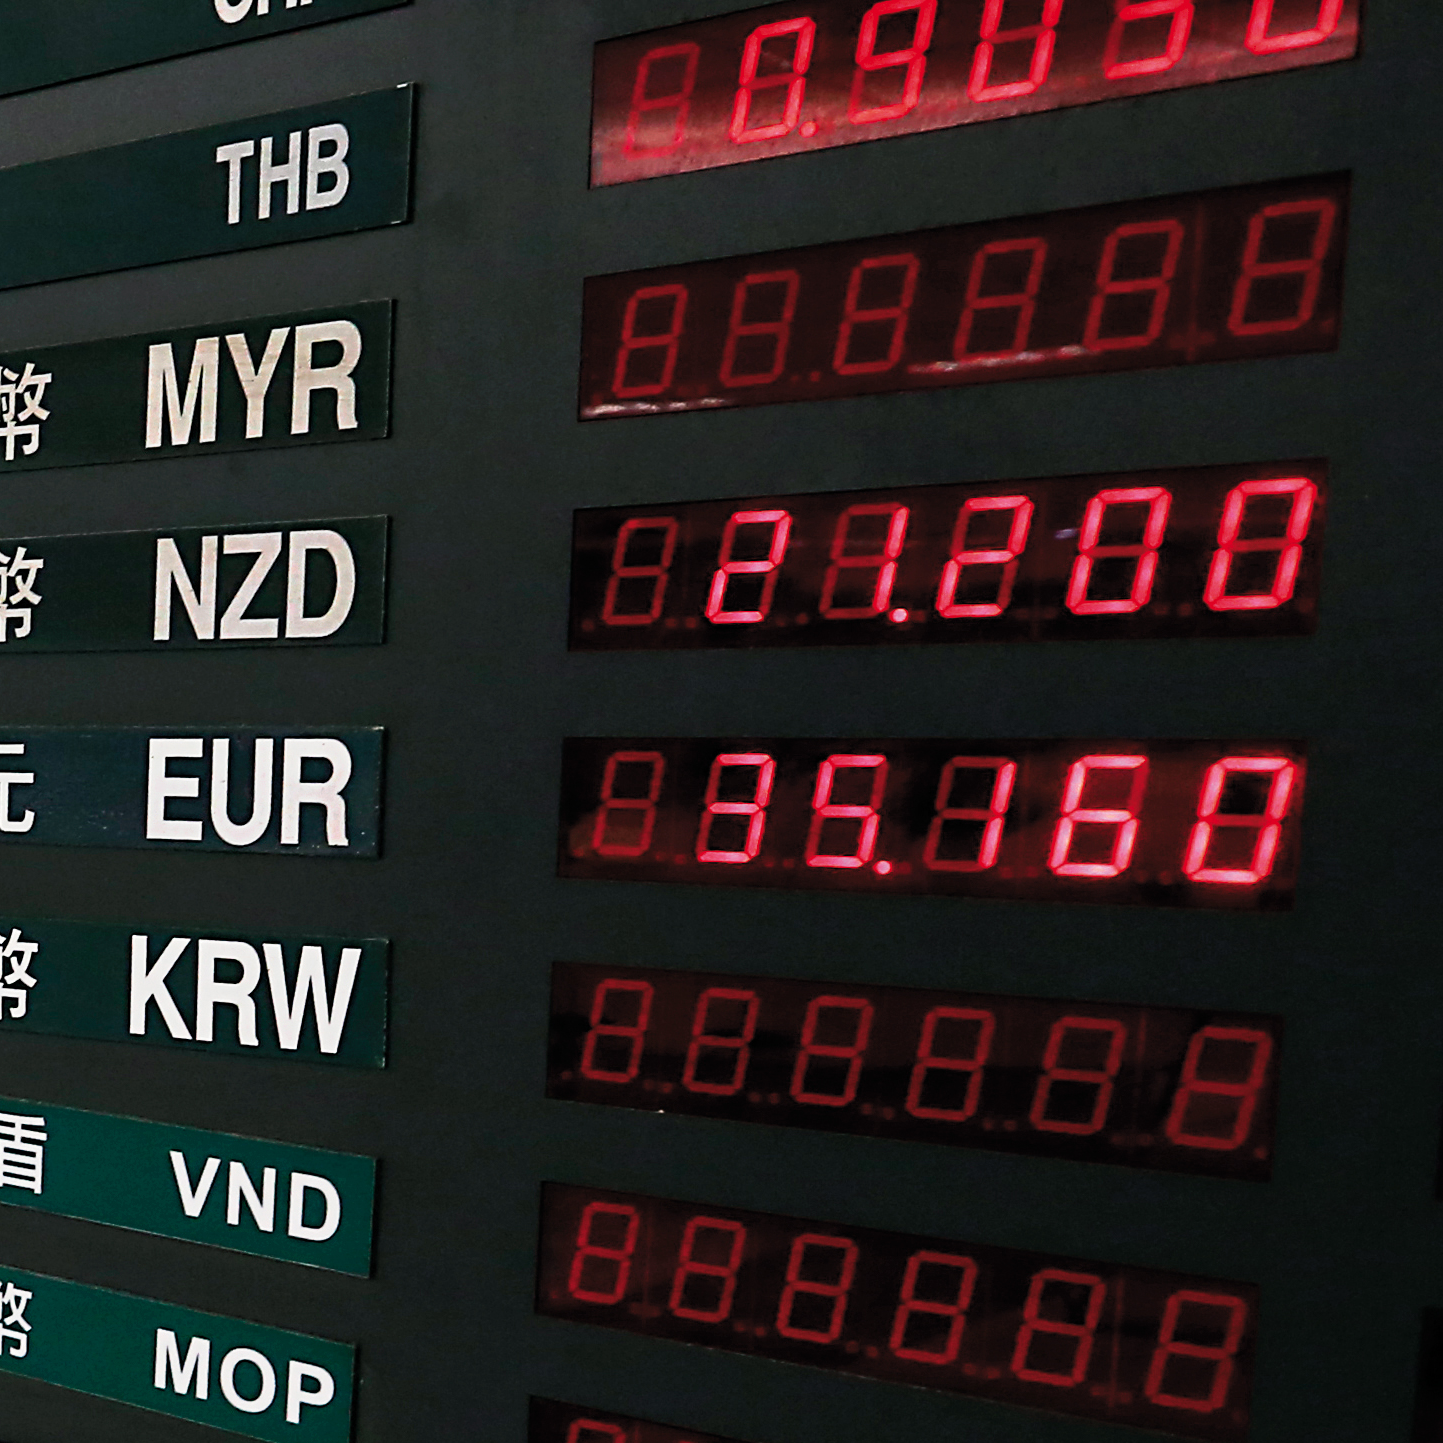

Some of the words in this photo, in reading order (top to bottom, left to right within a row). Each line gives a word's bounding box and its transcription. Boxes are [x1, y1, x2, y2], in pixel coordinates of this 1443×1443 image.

[216, 124, 349, 224] THB
[146, 320, 361, 448] MYR
[154, 530, 355, 640] NZD
[147, 739, 351, 846] EUR
[130, 935, 361, 1053] KRW
[170, 1151, 340, 1240] VND
[155, 1329, 334, 1423] MOP
